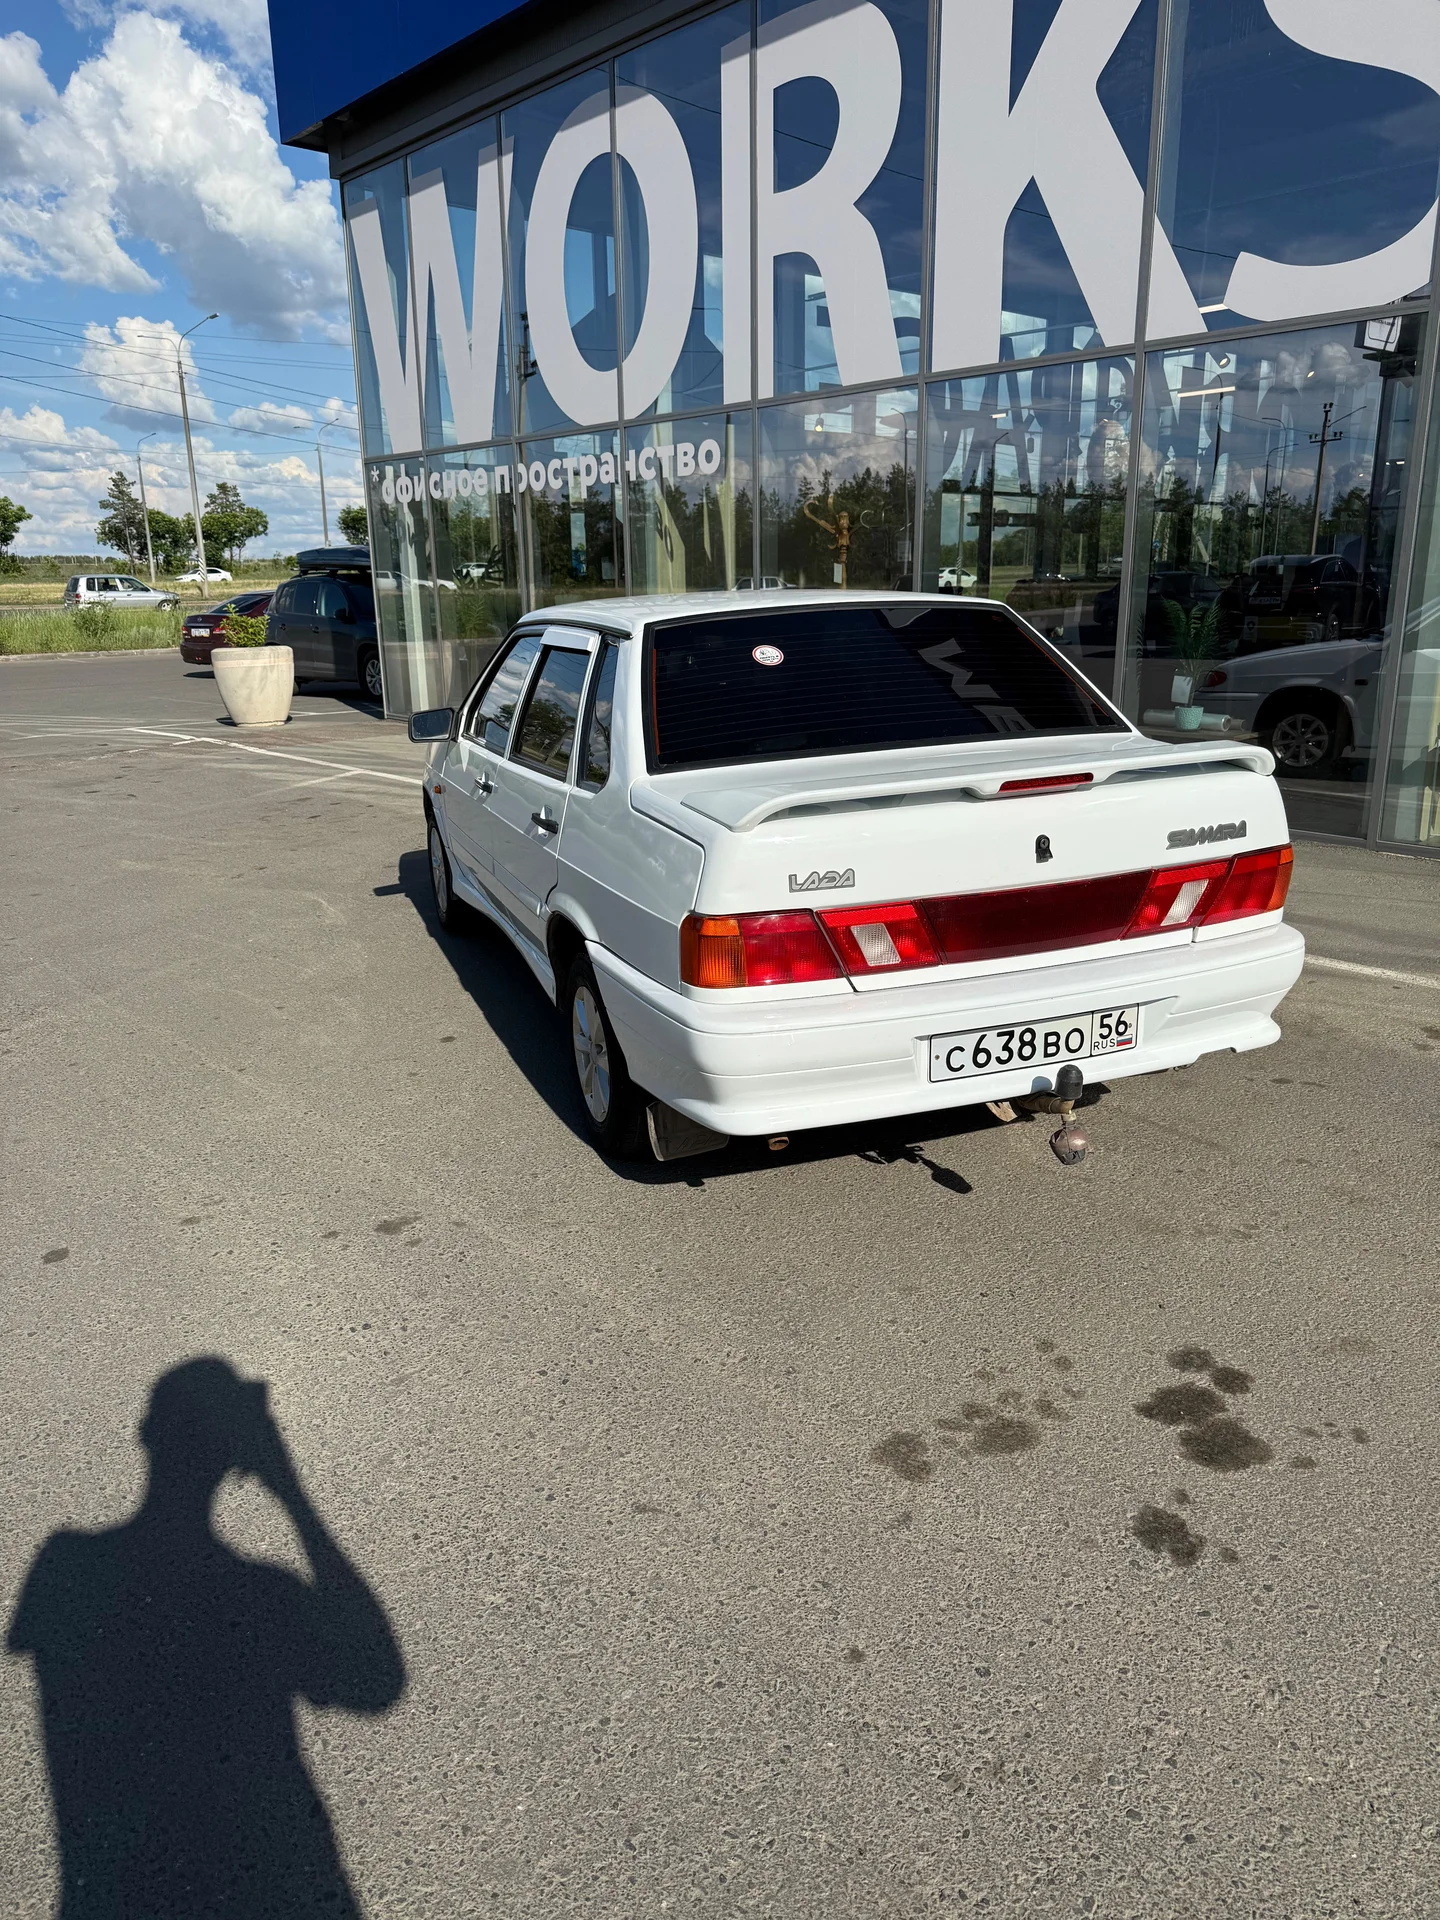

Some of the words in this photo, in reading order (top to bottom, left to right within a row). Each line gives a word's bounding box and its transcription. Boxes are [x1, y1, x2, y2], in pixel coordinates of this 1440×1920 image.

[494, 438, 721, 504] пространство
[1166, 819, 1247, 850] SAMARA
[788, 868, 855, 893] LADA
[1099, 1010, 1129, 1040] 56
[1093, 1038, 1116, 1050] RUS
